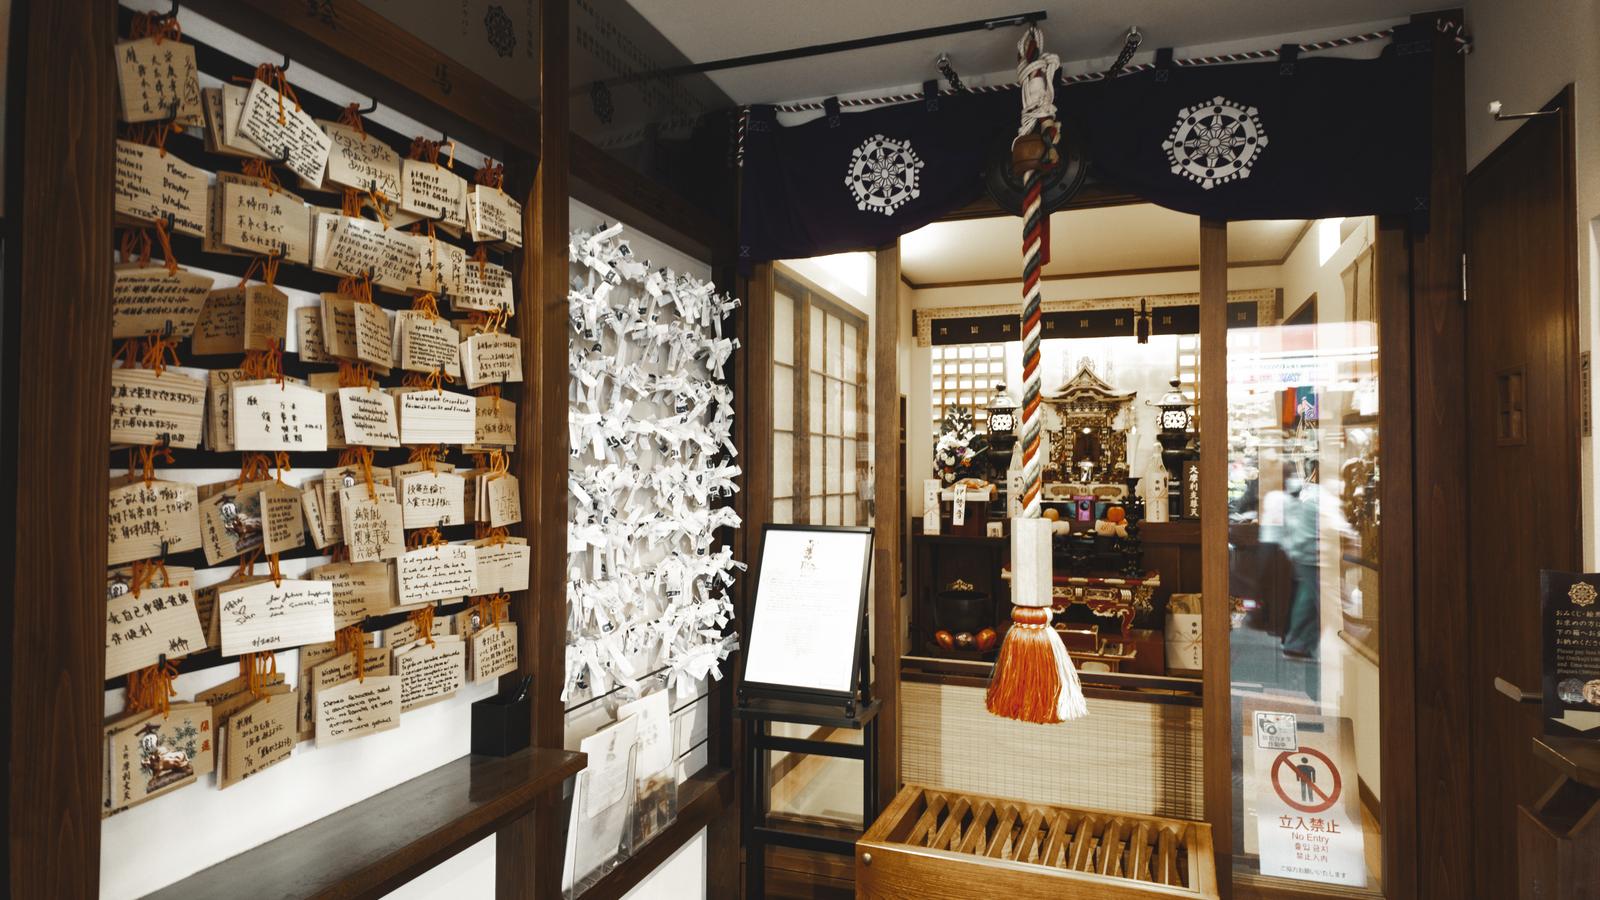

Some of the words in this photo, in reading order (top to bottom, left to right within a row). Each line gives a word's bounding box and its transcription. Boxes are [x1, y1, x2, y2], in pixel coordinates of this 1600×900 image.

[1279, 815, 1341, 834] 立入禁止
[1291, 832, 1304, 842] No
[1306, 833, 1329, 845] Entry
